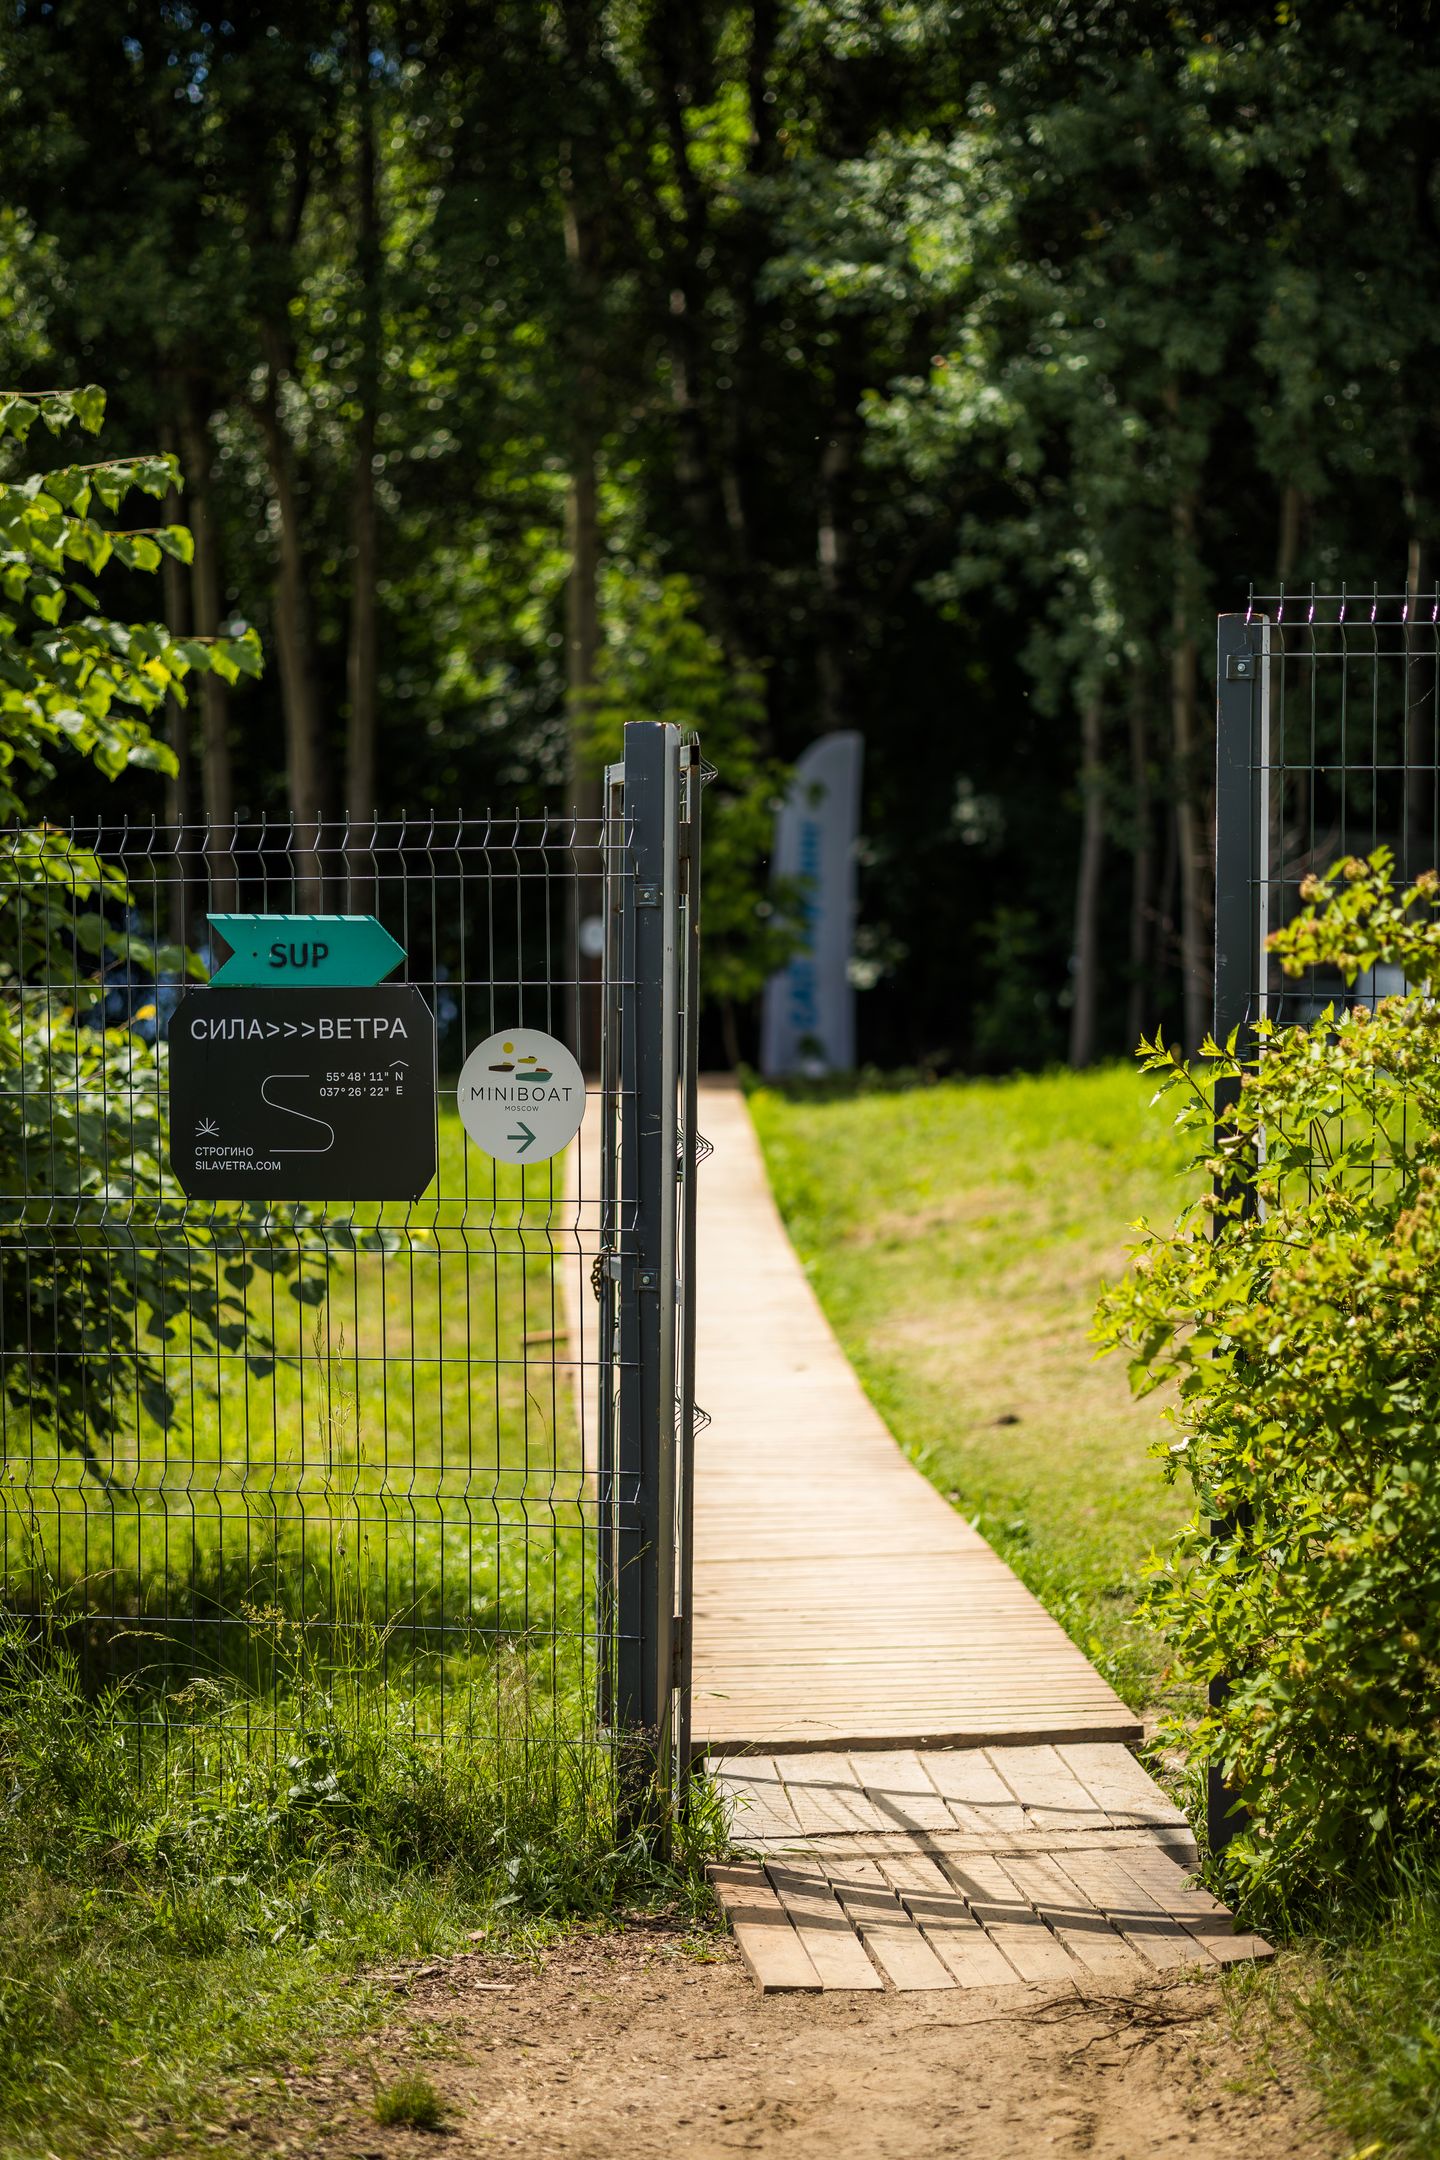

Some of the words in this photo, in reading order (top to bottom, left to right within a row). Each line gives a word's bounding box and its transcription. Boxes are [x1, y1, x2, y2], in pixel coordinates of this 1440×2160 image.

[268, 943, 329, 969] SUP
[395, 1071, 404, 1081] N
[396, 1085, 404, 1096] E
[471, 1086, 573, 1102] MINIBOAT
[195, 1146, 255, 1157] СТРОГИНО
[195, 1160, 282, 1171] SILAVETRA.COM
